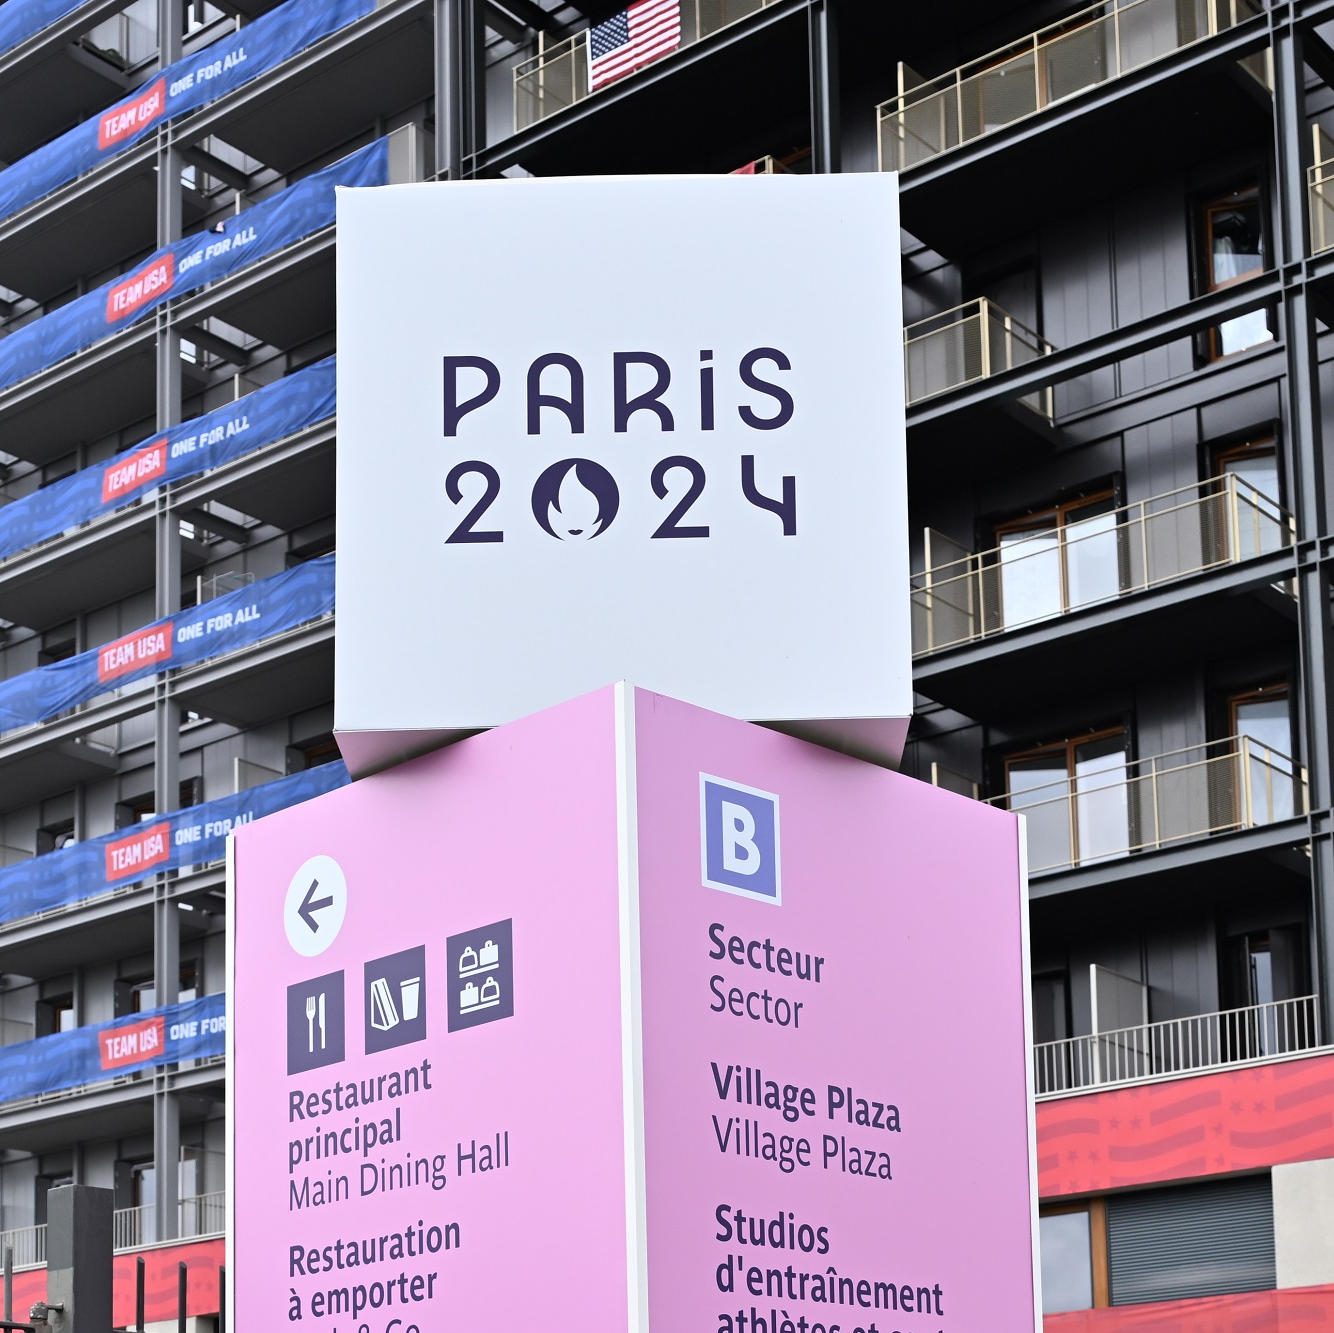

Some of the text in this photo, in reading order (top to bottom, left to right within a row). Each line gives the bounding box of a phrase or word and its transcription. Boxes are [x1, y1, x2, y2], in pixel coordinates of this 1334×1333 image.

[169, 48, 247, 98] ONE FOR ALL
[104, 91, 160, 139] TEAM USA
[178, 227, 257, 273] ONE FOR ALL
[112, 265, 167, 312] TEAM USA
[444, 347, 794, 437] PARIS
[171, 416, 250, 458] ONE FOR ALL
[108, 449, 160, 492] TEAM USA
[445, 455, 796, 544] 2024
[177, 604, 261, 643] ONE FOR ALL
[103, 632, 165, 672] TEAM USA
[111, 835, 163, 871] TEAM USA
[175, 826, 201, 846] ONE
[205, 819, 232, 837] FOR
[721, 800, 761, 876] B
[709, 923, 824, 983] Secteur
[710, 975, 803, 1028] Sector
[105, 1027, 159, 1058] TEAM USA
[170, 1015, 225, 1041] ONE FOR
[290, 1059, 432, 1124] Restaurant
[711, 1062, 901, 1132] Village Plaza
[289, 1107, 400, 1175] principal
[712, 1115, 892, 1180] Village Plaza
[290, 1131, 508, 1211] Main Dining Hall
[290, 1220, 460, 1277] Restauration
[716, 1204, 829, 1254] Studios
[289, 1272, 437, 1321] à emporter
[716, 1254, 943, 1319] d'entraînement
